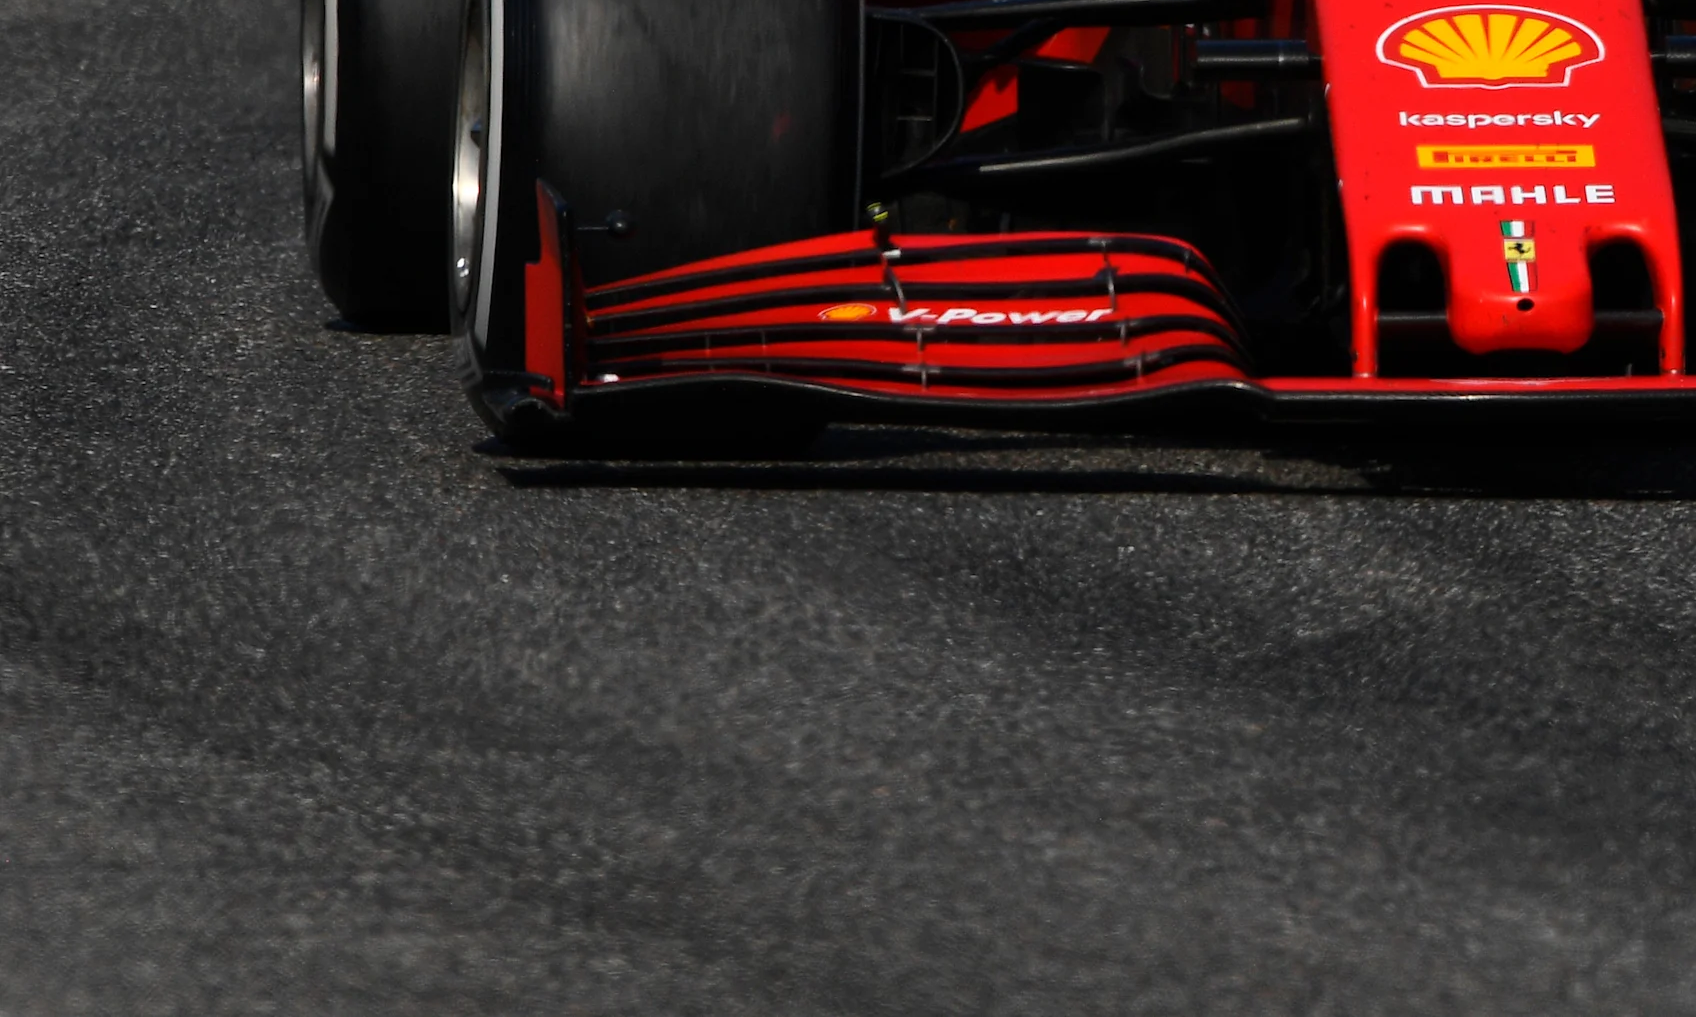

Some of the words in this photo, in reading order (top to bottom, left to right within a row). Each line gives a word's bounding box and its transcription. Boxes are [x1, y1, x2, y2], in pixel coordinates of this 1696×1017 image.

[1399, 111, 1600, 128] kaspersky
[1432, 150, 1578, 164] PIRELLI
[1411, 185, 1615, 205] MAHLE
[888, 307, 1114, 324] V-Power
